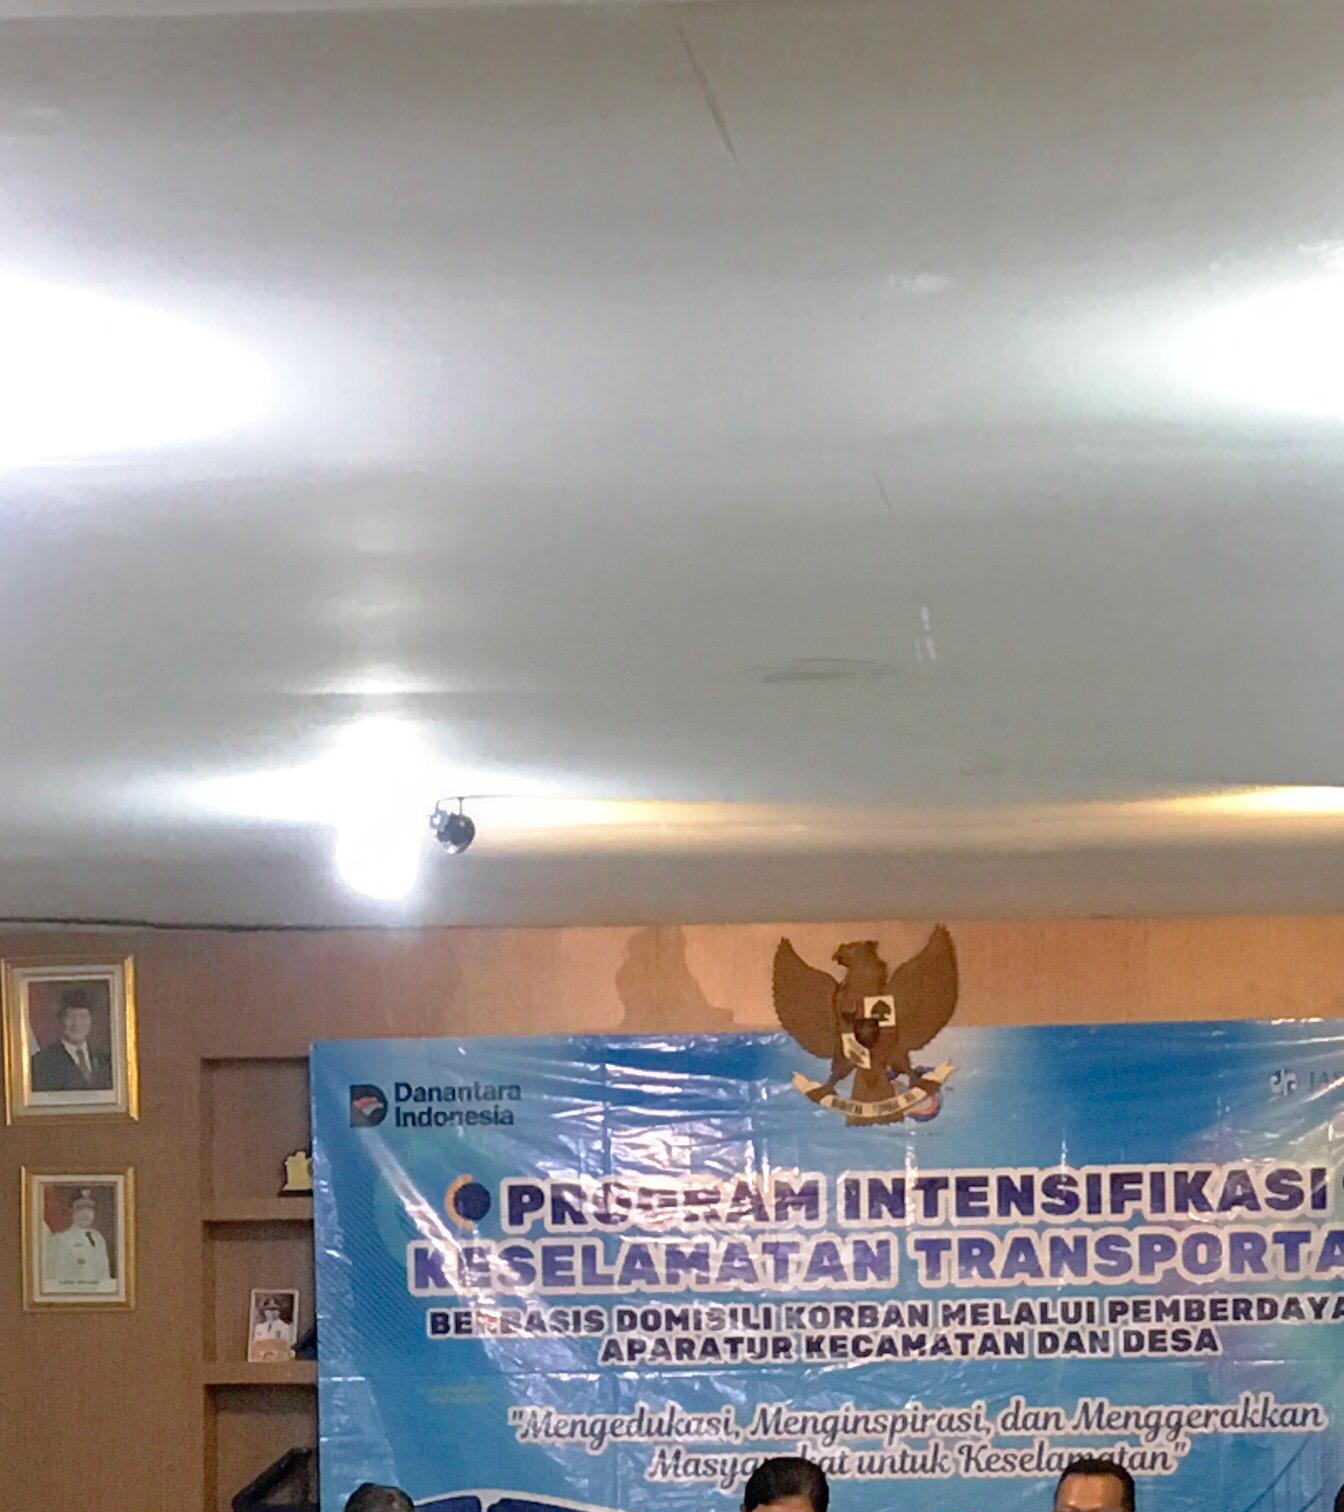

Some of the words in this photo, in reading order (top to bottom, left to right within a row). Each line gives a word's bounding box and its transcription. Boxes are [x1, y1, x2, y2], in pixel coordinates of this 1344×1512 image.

[394, 1081, 522, 1103] Danantara
[394, 1104, 515, 1128] Indonesia
[507, 1179, 820, 1226] PROGRAM
[843, 1167, 1328, 1221] INTENSIFIKASI
[413, 1238, 892, 1289] KESELAMATAN
[616, 1306, 773, 1332] DOMISILI
[785, 1303, 930, 1329] KORBAN
[942, 1301, 1096, 1327] MELALUI
[600, 1336, 793, 1361] APARATUR
[805, 1331, 1027, 1359] KECAMATAN
[1037, 1330, 1110, 1355] DAN
[1123, 1328, 1220, 1353] DESA
[512, 1405, 741, 1449] "Mengedukasi,
[750, 1405, 992, 1446] Menginspirasi,
[1001, 1400, 1064, 1432] dan
[1072, 1397, 1322, 1442] Menggerakkan
[648, 1442, 850, 1489] Masyaat
[856, 1441, 952, 1475] untuk
